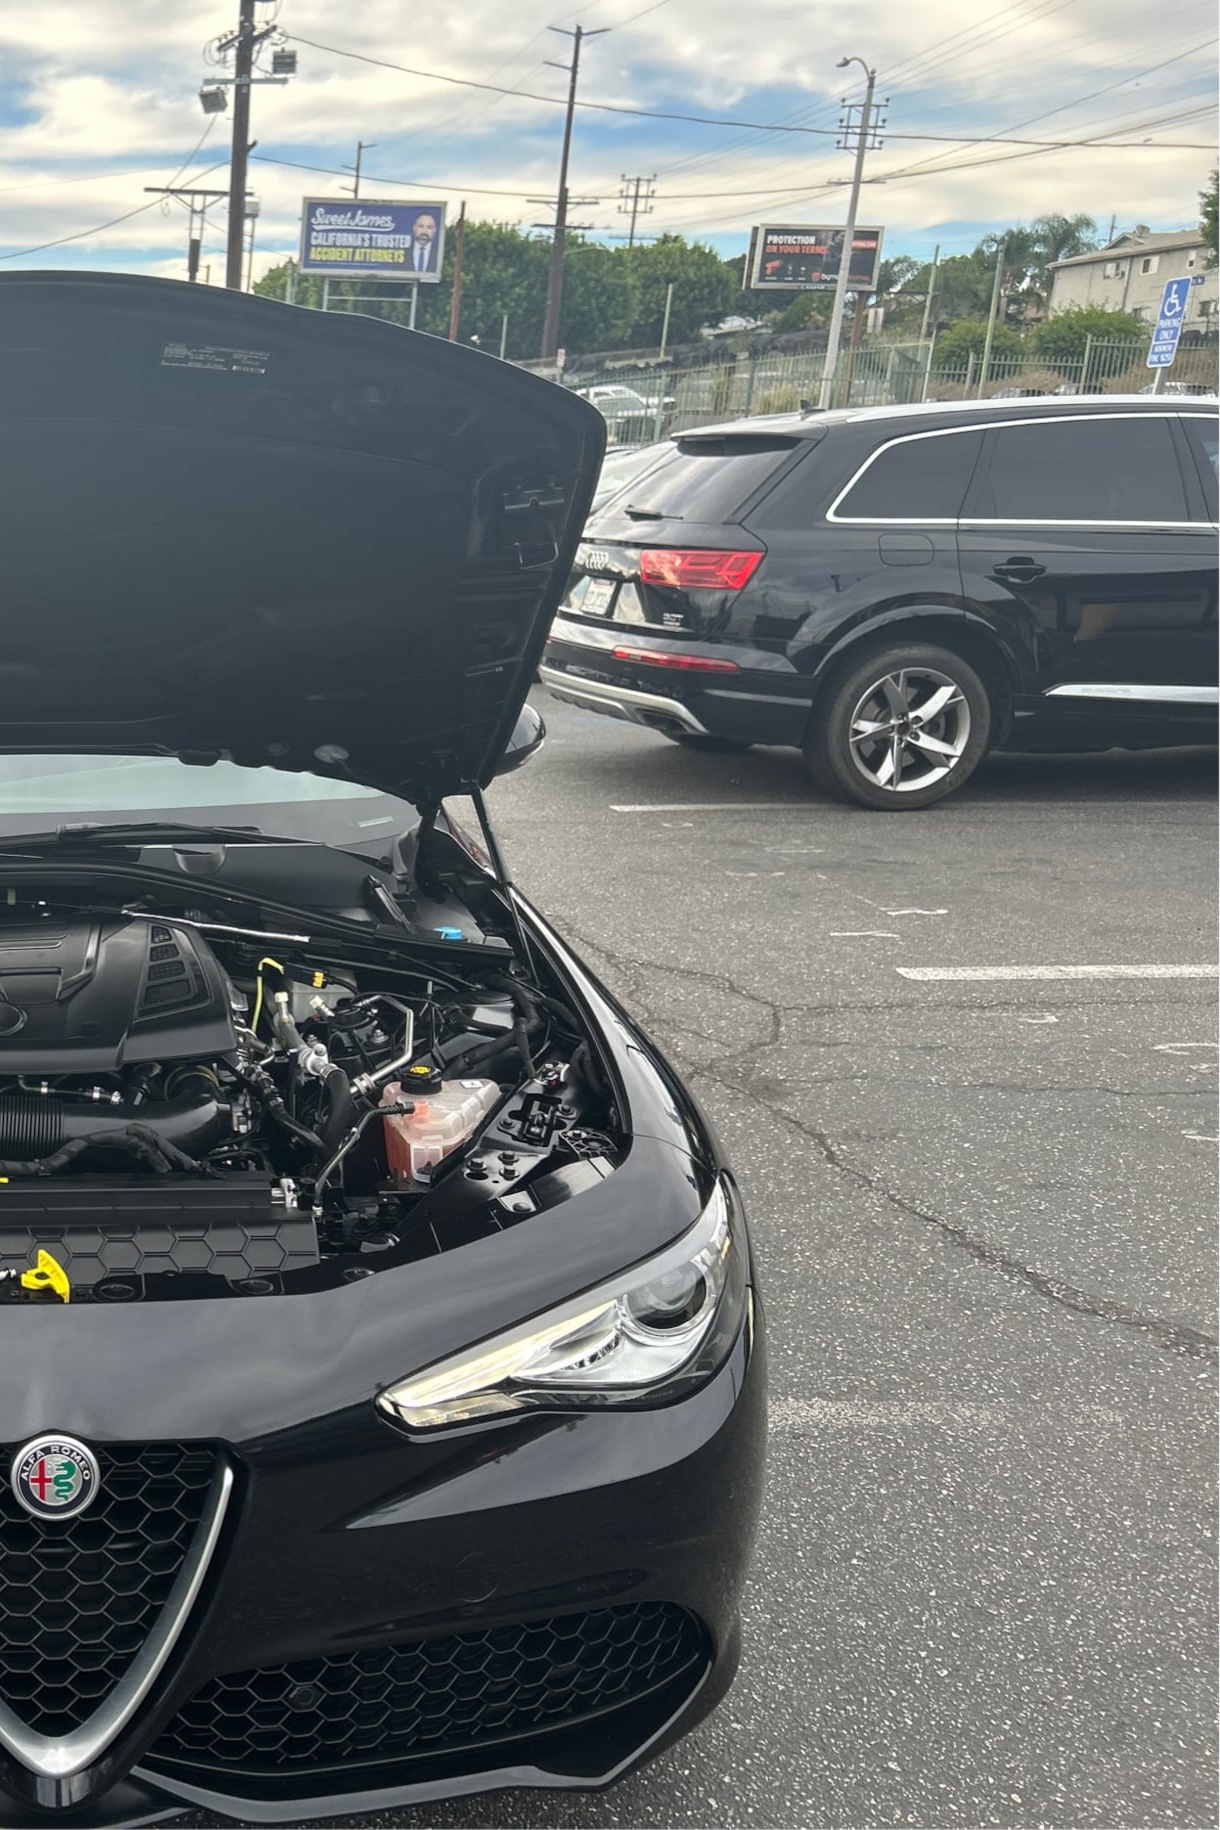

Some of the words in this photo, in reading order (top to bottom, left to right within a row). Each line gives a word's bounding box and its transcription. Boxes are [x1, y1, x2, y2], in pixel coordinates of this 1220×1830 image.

[311, 208, 352, 226] Sweet
[352, 210, 395, 228] James
[311, 232, 370, 248] CALIFORNIA'S
[371, 234, 412, 249] TRUSTED
[767, 235, 816, 245] PROTECTION
[310, 247, 353, 262] ACCIDENT
[354, 248, 405, 263] ATTORNEYS
[766, 245, 777, 253] ON
[779, 245, 800, 254] YOUR
[1159, 318, 1180, 328] PARKING
[1159, 330, 1173, 340] ONLY
[21, 1450, 45, 1481] ALFA
[50, 1445, 91, 1480] ROMEO
